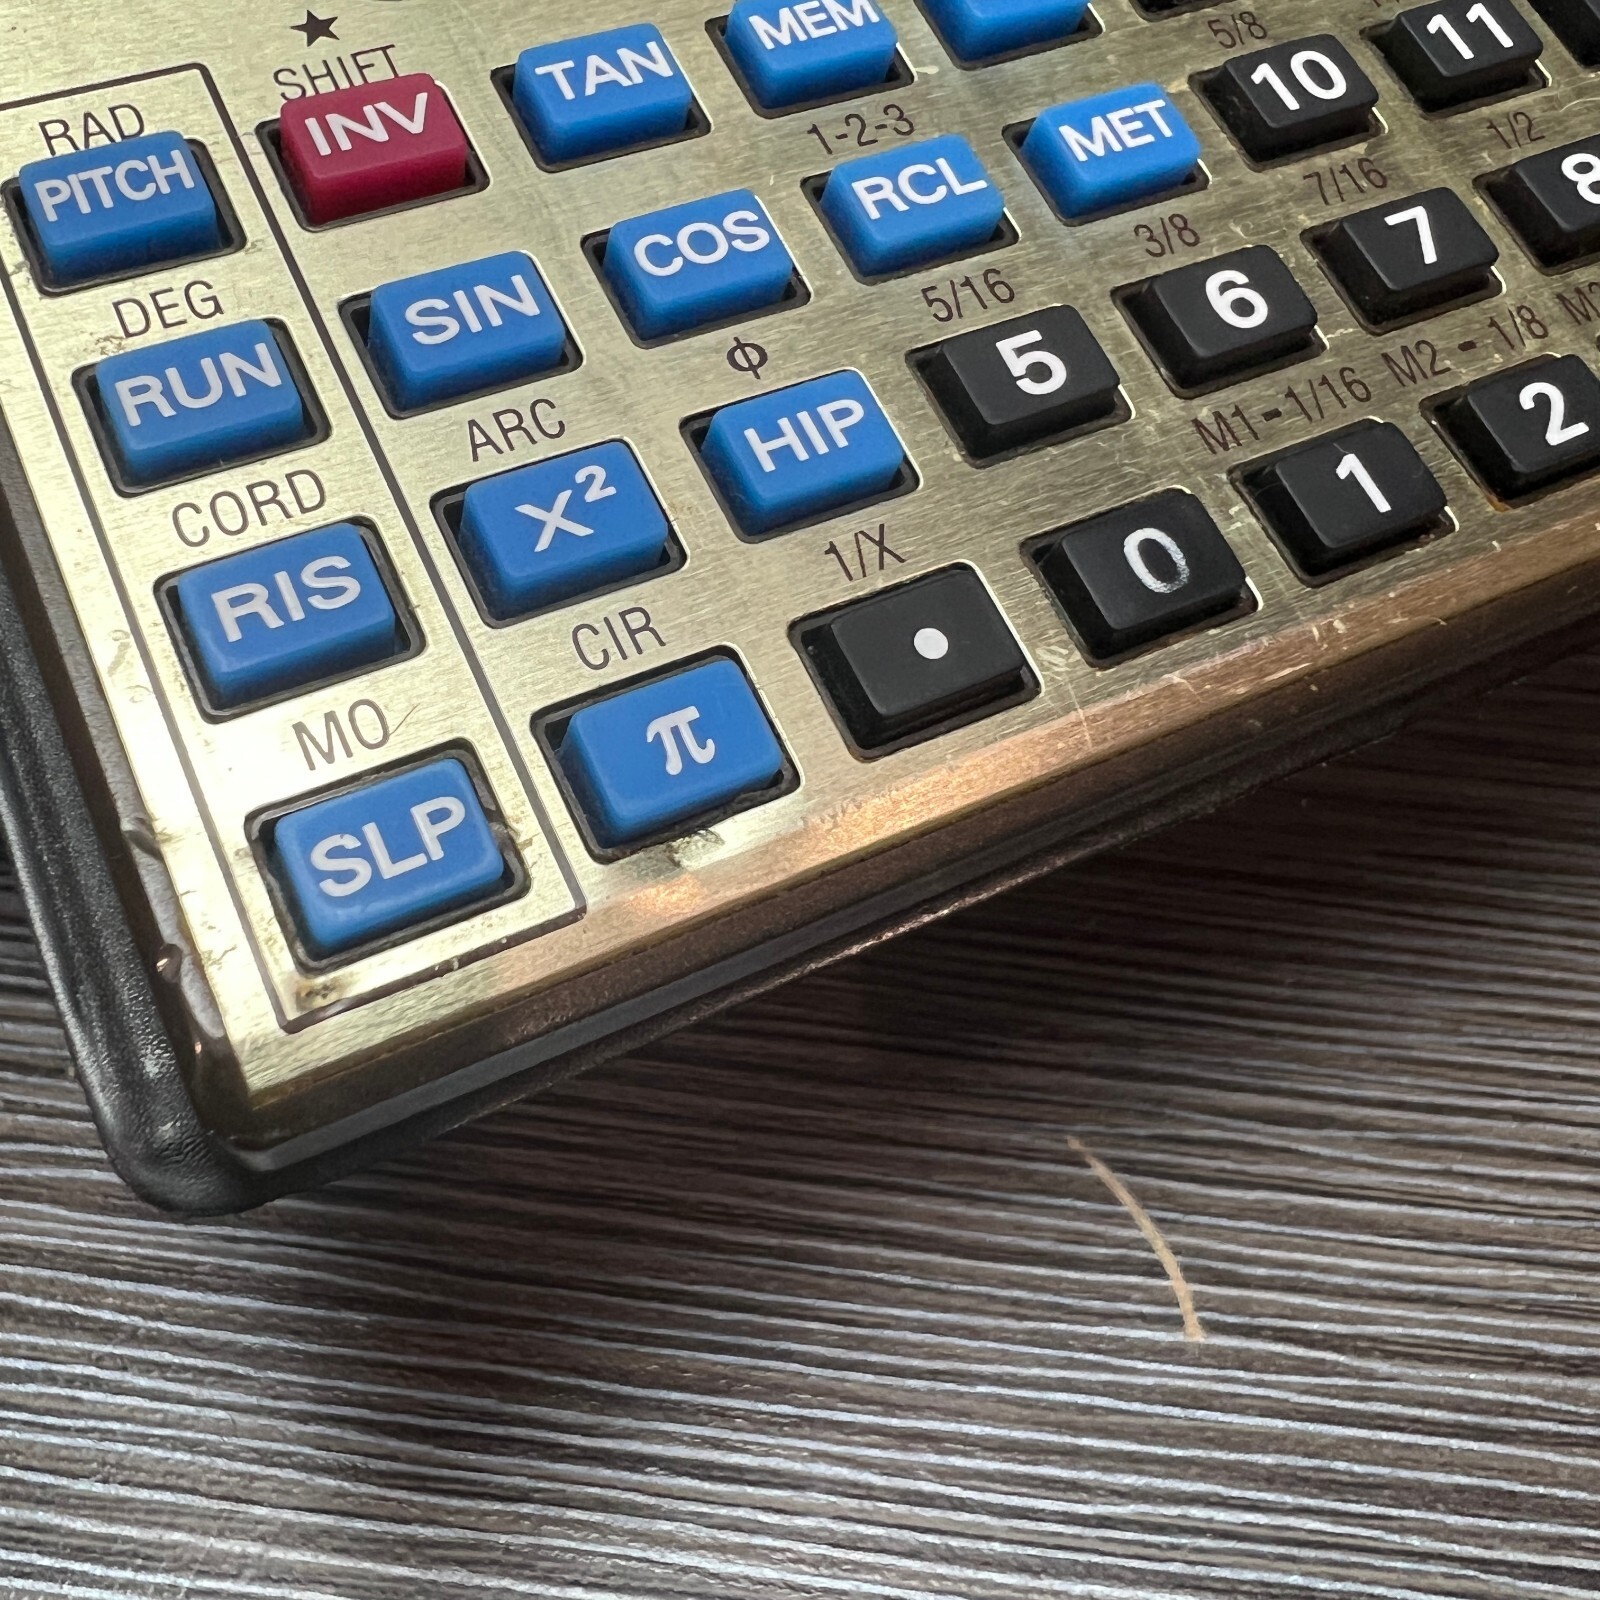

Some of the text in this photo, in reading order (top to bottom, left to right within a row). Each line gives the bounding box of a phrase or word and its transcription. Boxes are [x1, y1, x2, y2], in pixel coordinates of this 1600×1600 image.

[749, 0, 880, 50] MEM
[1207, 11, 1268, 49] 5/8
[1426, 2, 1514, 60] 11
[273, 44, 401, 101] SHIFT
[535, 41, 673, 100] TAN
[1250, 50, 1347, 111] 10
[39, 104, 145, 156] RAD
[304, 92, 428, 156] INV
[807, 103, 915, 154] 1-2-3
[1058, 99, 1173, 162] MET
[1487, 111, 1546, 149] 1/2
[34, 149, 195, 222] PITCH
[851, 157, 988, 220] RCL
[1303, 157, 1388, 206] 7/16
[1561, 152, 1600, 206] 8
[633, 210, 770, 277] COS
[1133, 213, 1200, 258] 3/8
[1384, 205, 1438, 265] 7
[112, 280, 225, 339] DEG
[405, 274, 540, 345] SIN
[921, 268, 1015, 322] 5/16
[1205, 269, 1268, 329] 6
[114, 342, 282, 427] RUN
[995, 329, 1067, 395] 5
[467, 398, 566, 462] ARC
[743, 399, 865, 473] HIP
[1518, 381, 1590, 446] 2
[171, 468, 327, 548] CORD
[1335, 453, 1392, 514] 1
[823, 523, 905, 582] 1/X
[1123, 527, 1190, 594] 0
[211, 555, 362, 643] RIS
[571, 605, 667, 671] CIR
[291, 698, 390, 771] MO
[646, 705, 716, 775] π
[309, 796, 466, 898] SLP
